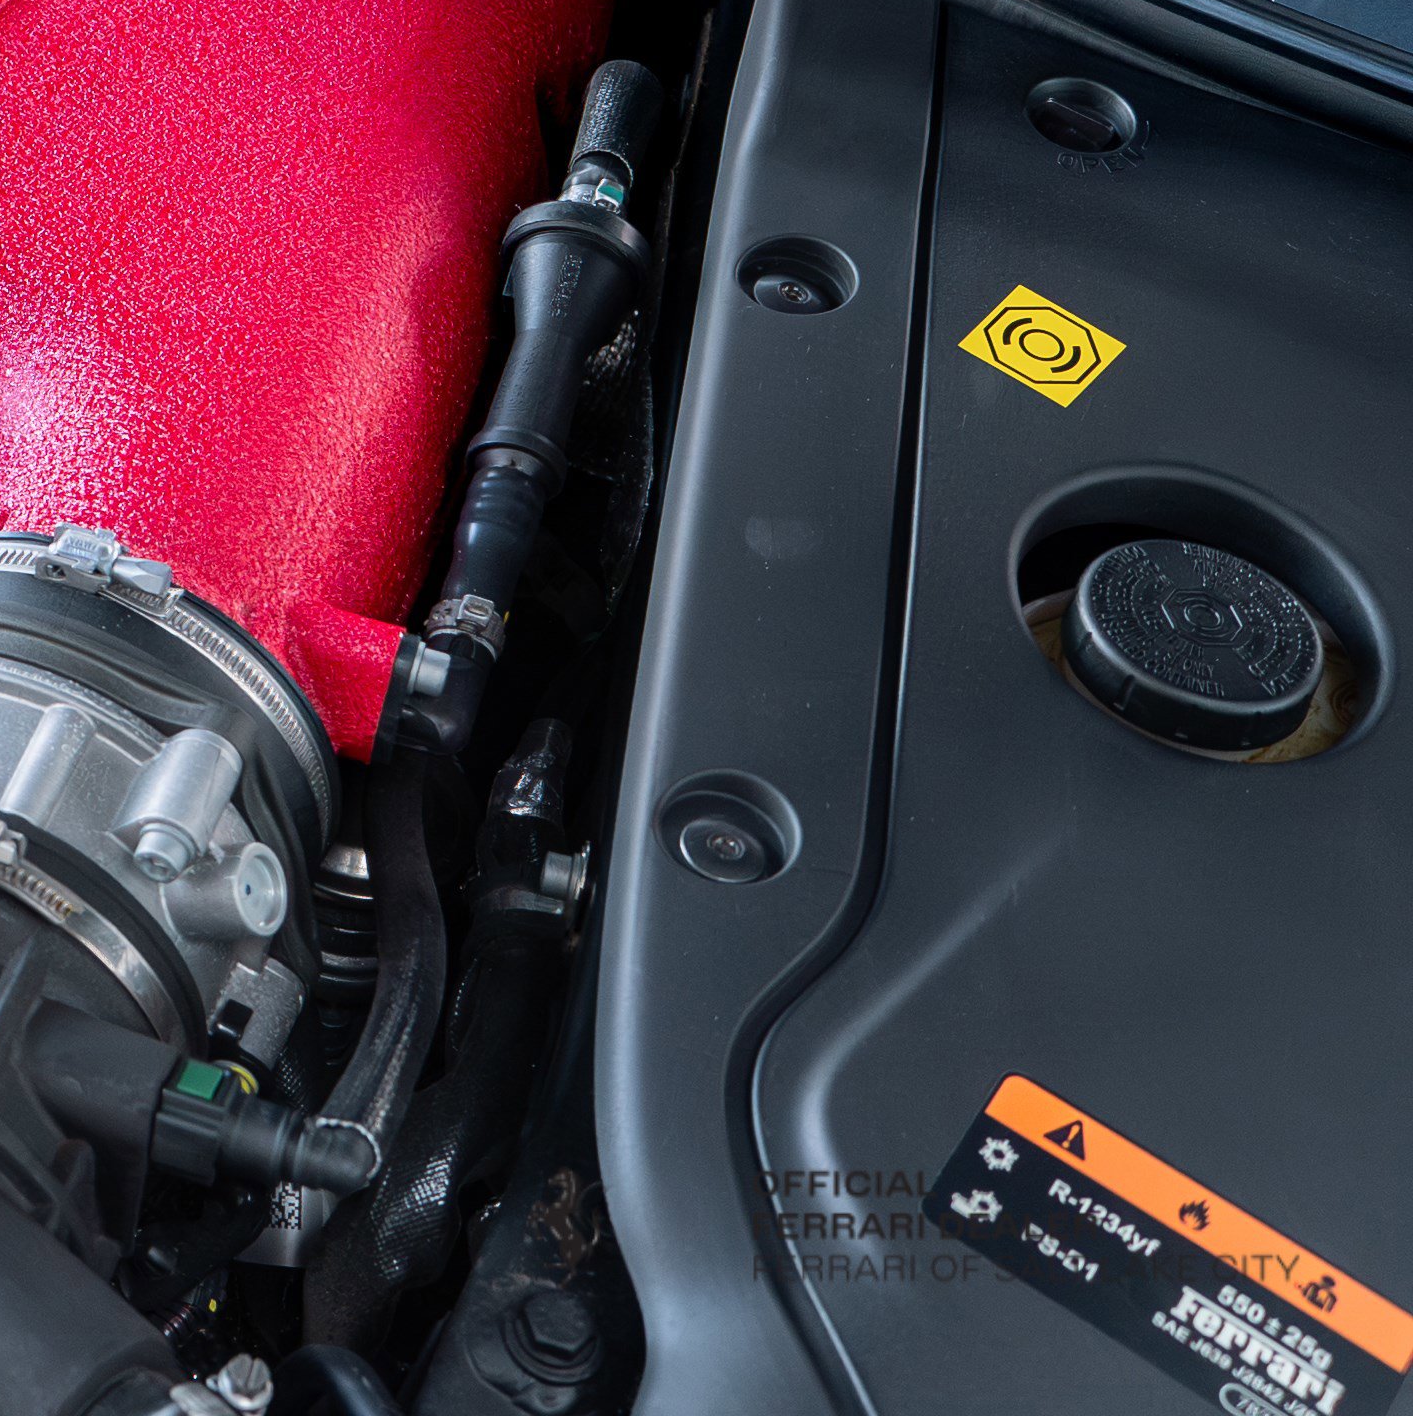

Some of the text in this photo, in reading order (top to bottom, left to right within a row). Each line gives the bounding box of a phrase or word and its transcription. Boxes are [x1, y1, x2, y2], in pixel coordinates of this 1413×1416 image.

[1047, 1178, 1162, 1258] R-1234yf
[1150, 1310, 1191, 1345] SAE
[1170, 1284, 1347, 1416] Ferrari
[1217, 1284, 1267, 1326] 550
[1281, 1324, 1334, 1372] 25g
